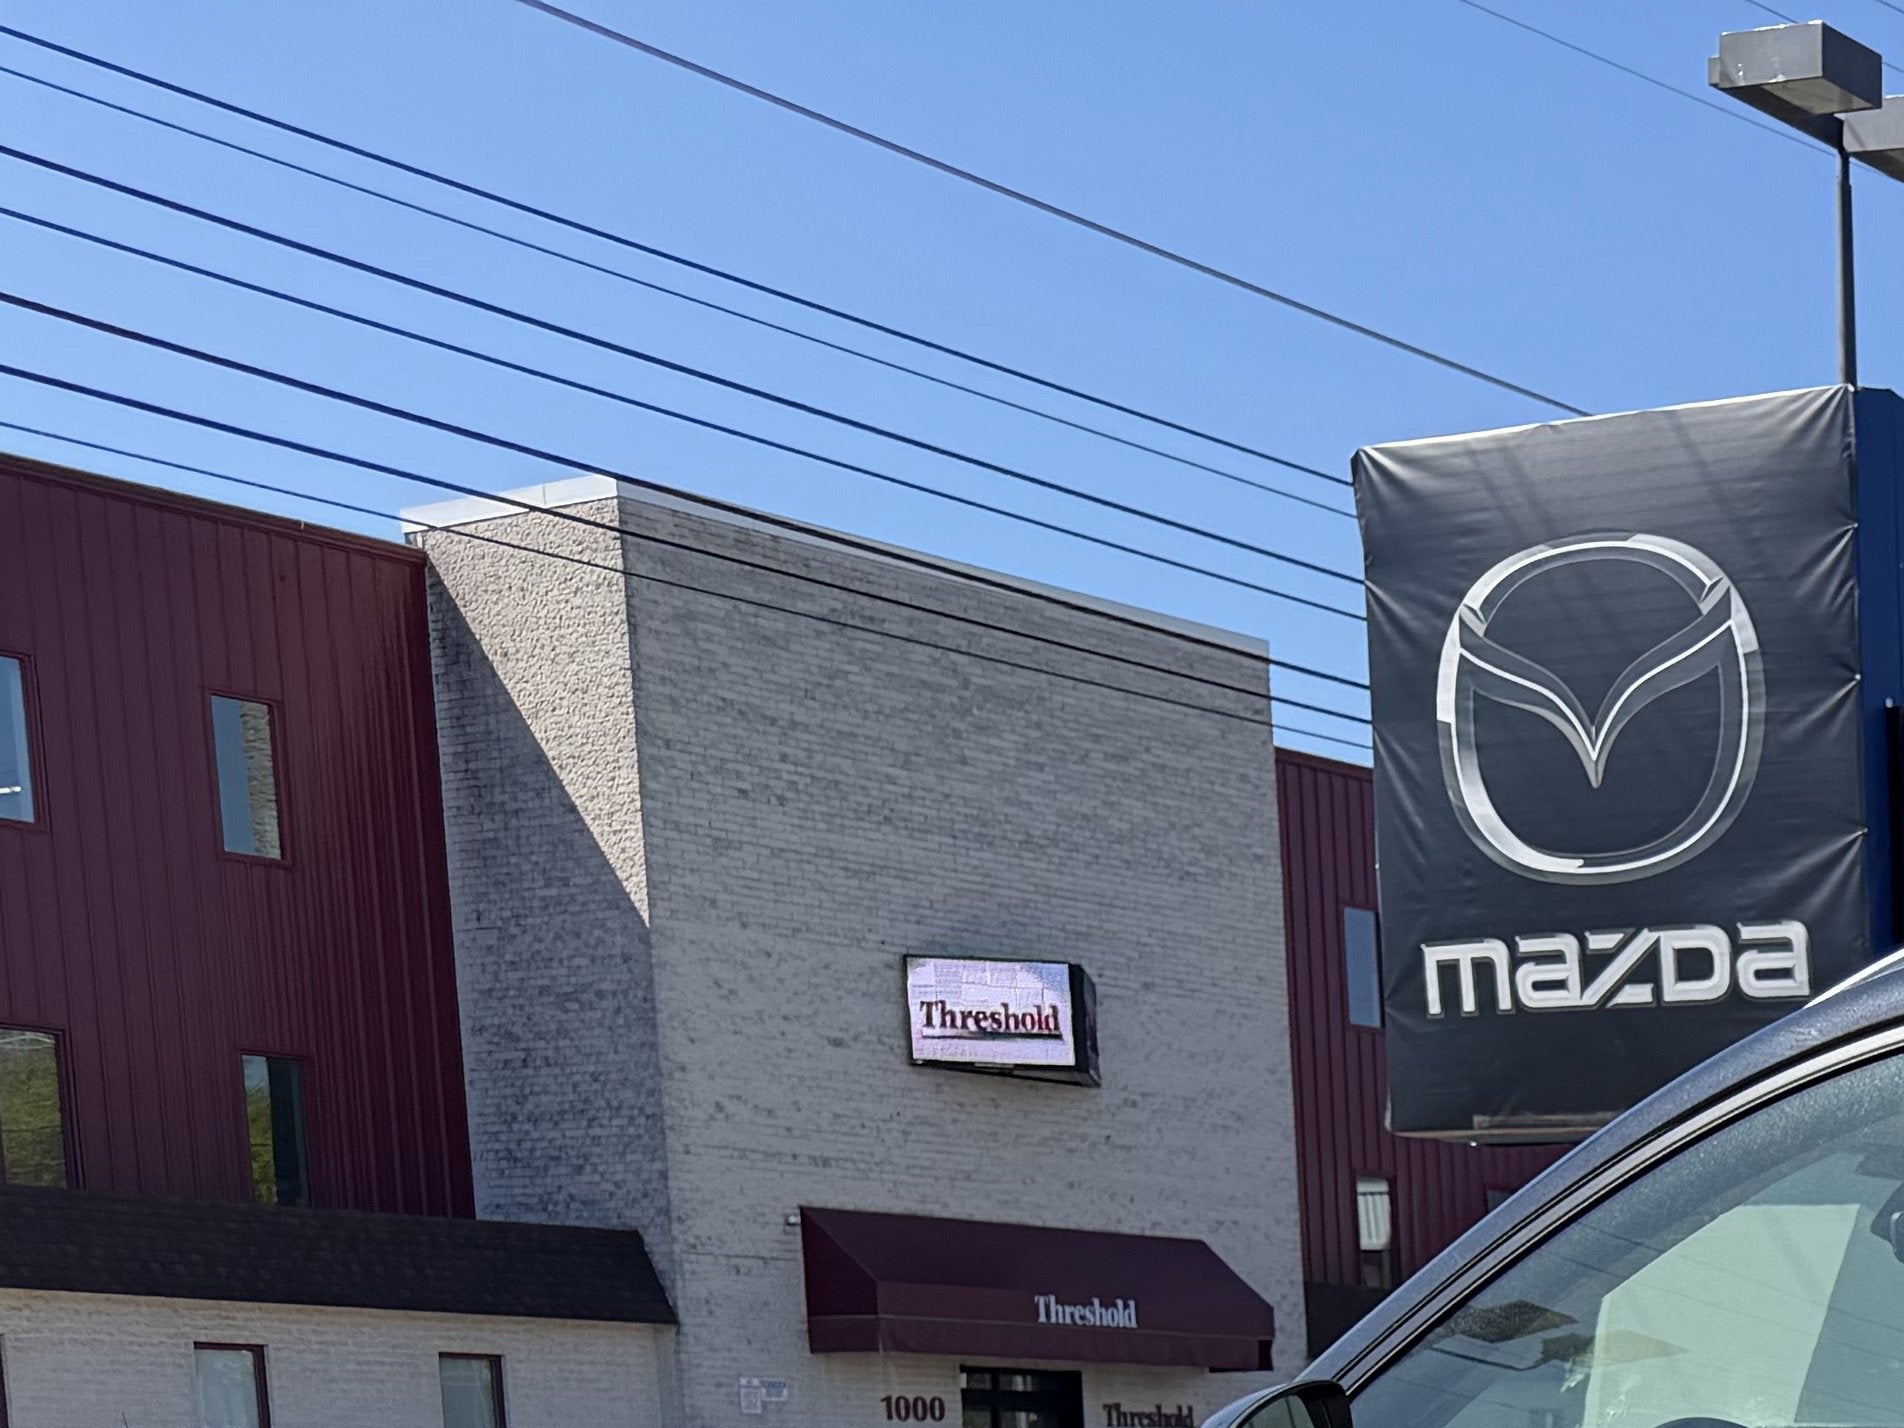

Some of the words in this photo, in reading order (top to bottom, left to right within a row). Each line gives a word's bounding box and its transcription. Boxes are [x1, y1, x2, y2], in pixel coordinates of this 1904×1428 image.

[919, 999, 1061, 1034] Threshold
[1034, 1294, 1138, 1329] Threshold
[880, 1395, 946, 1422] 1000
[1102, 1402, 1196, 1428] Threshold
